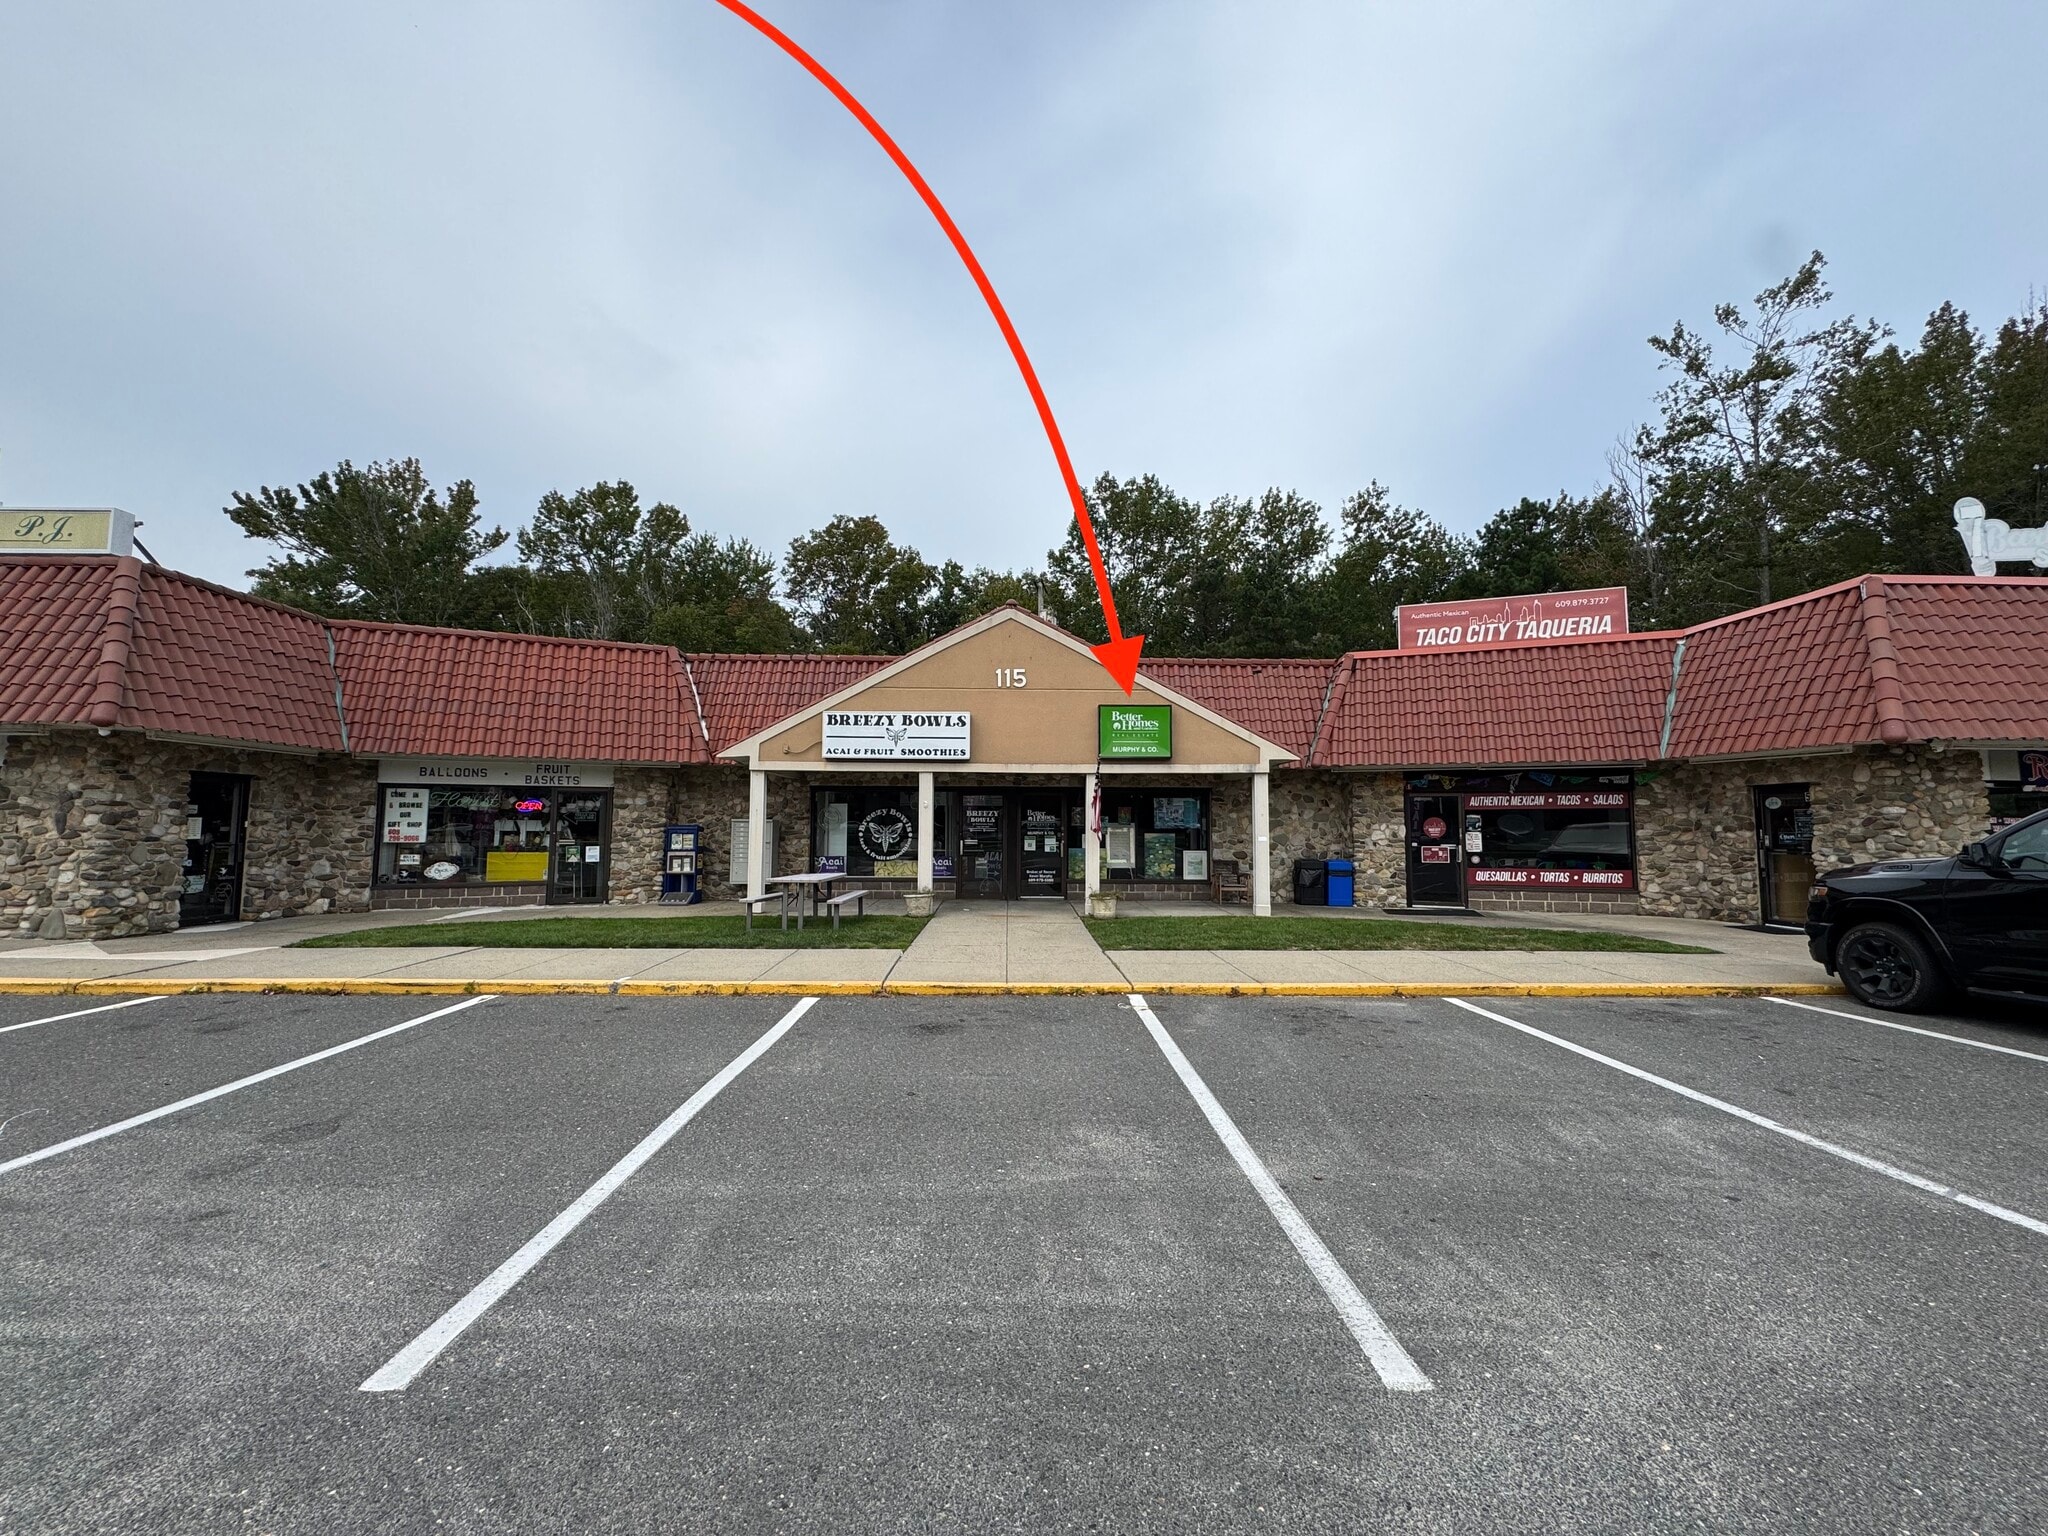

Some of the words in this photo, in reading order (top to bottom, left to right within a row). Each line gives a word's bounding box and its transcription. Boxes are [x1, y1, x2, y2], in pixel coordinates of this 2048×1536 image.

[14, 515, 73, 544] P.J.
[1555, 597, 1610, 608] 609.879.3727
[1411, 611, 1442, 619] Authentic
[1442, 609, 1470, 617] Mexican
[1416, 626, 1462, 646] TACO
[1466, 622, 1510, 644] CITY
[1516, 614, 1612, 640] TAQUERIA
[996, 668, 1026, 688] 115
[827, 714, 897, 726] BREEZY
[902, 714, 967, 727] BOWLS
[1112, 710, 1144, 720] Better
[1122, 720, 1158, 730] Homes
[420, 766, 488, 778] BALLOONS
[536, 764, 571, 774] FRUIT
[525, 776, 580, 785] BASKETS
[516, 801, 542, 810] OPEN
[1470, 796, 1510, 806] AUTHENTIC
[1510, 796, 1544, 806] MEXICAN
[1556, 795, 1581, 805] TACOS
[1592, 794, 1624, 804] SALADS
[1475, 871, 1527, 882] QUESADILLAS
[1540, 872, 1570, 882] TORTAS
[1582, 873, 1624, 884] BURRITOS
